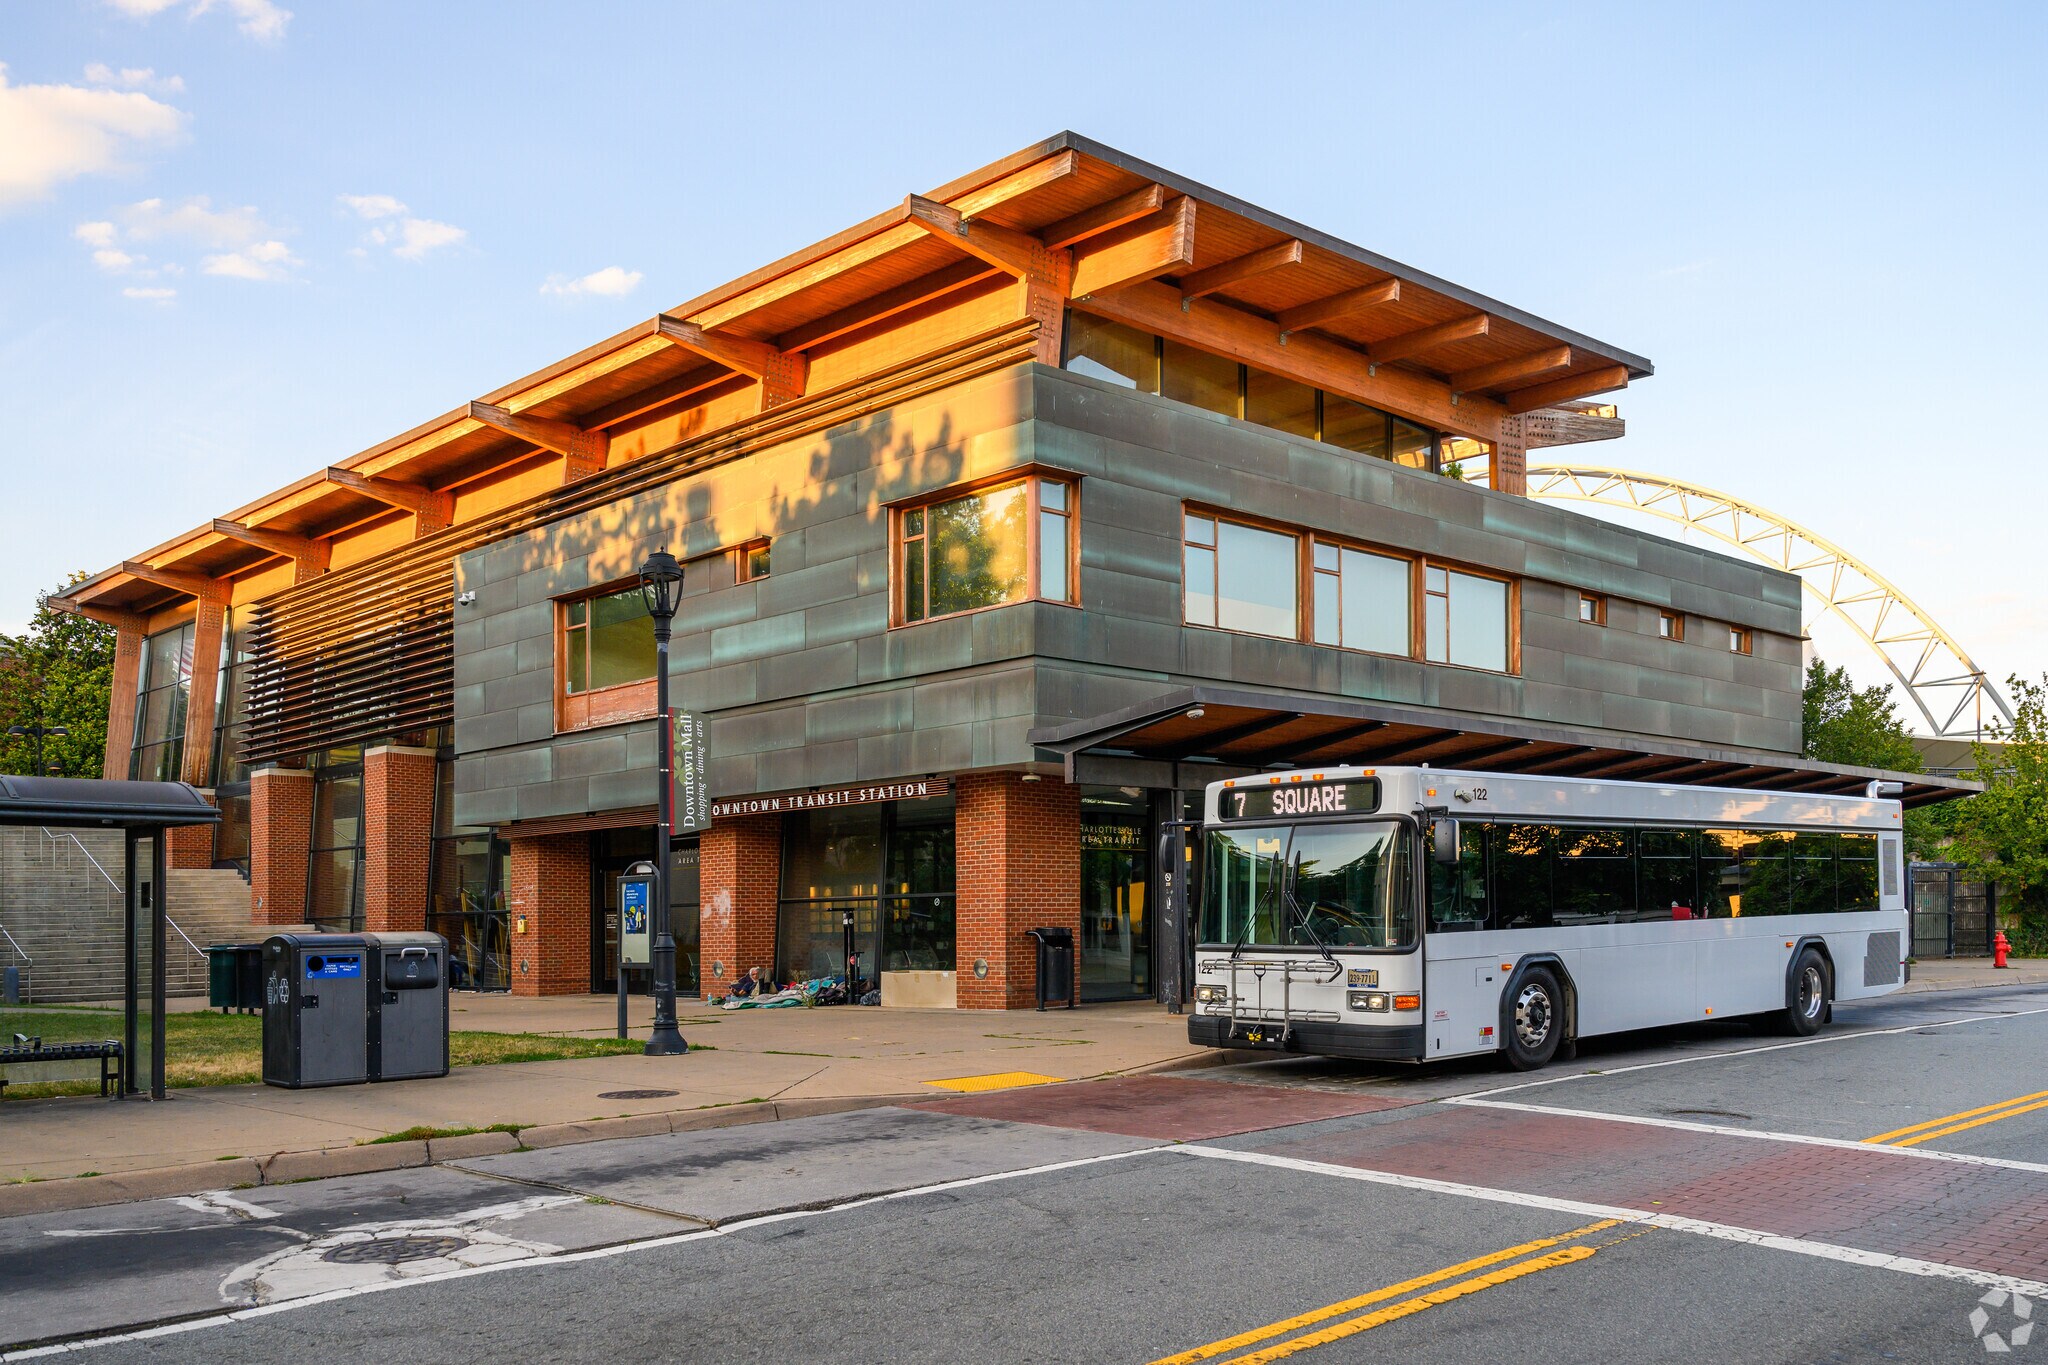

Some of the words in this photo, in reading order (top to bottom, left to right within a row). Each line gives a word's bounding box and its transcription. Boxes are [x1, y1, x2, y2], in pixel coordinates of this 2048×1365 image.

[680, 714, 693, 747] Mall
[696, 746, 706, 774] dining
[683, 750, 696, 828] Downtown
[697, 783, 707, 821] shopping
[712, 798, 780, 816] OWNTOWN
[788, 791, 850, 808] TRANSIT
[860, 782, 927, 801] STATION
[1234, 792, 1246, 817] 7
[1272, 784, 1347, 815] SQUARE
[1472, 788, 1488, 801] 122
[1081, 835, 1098, 844] REA
